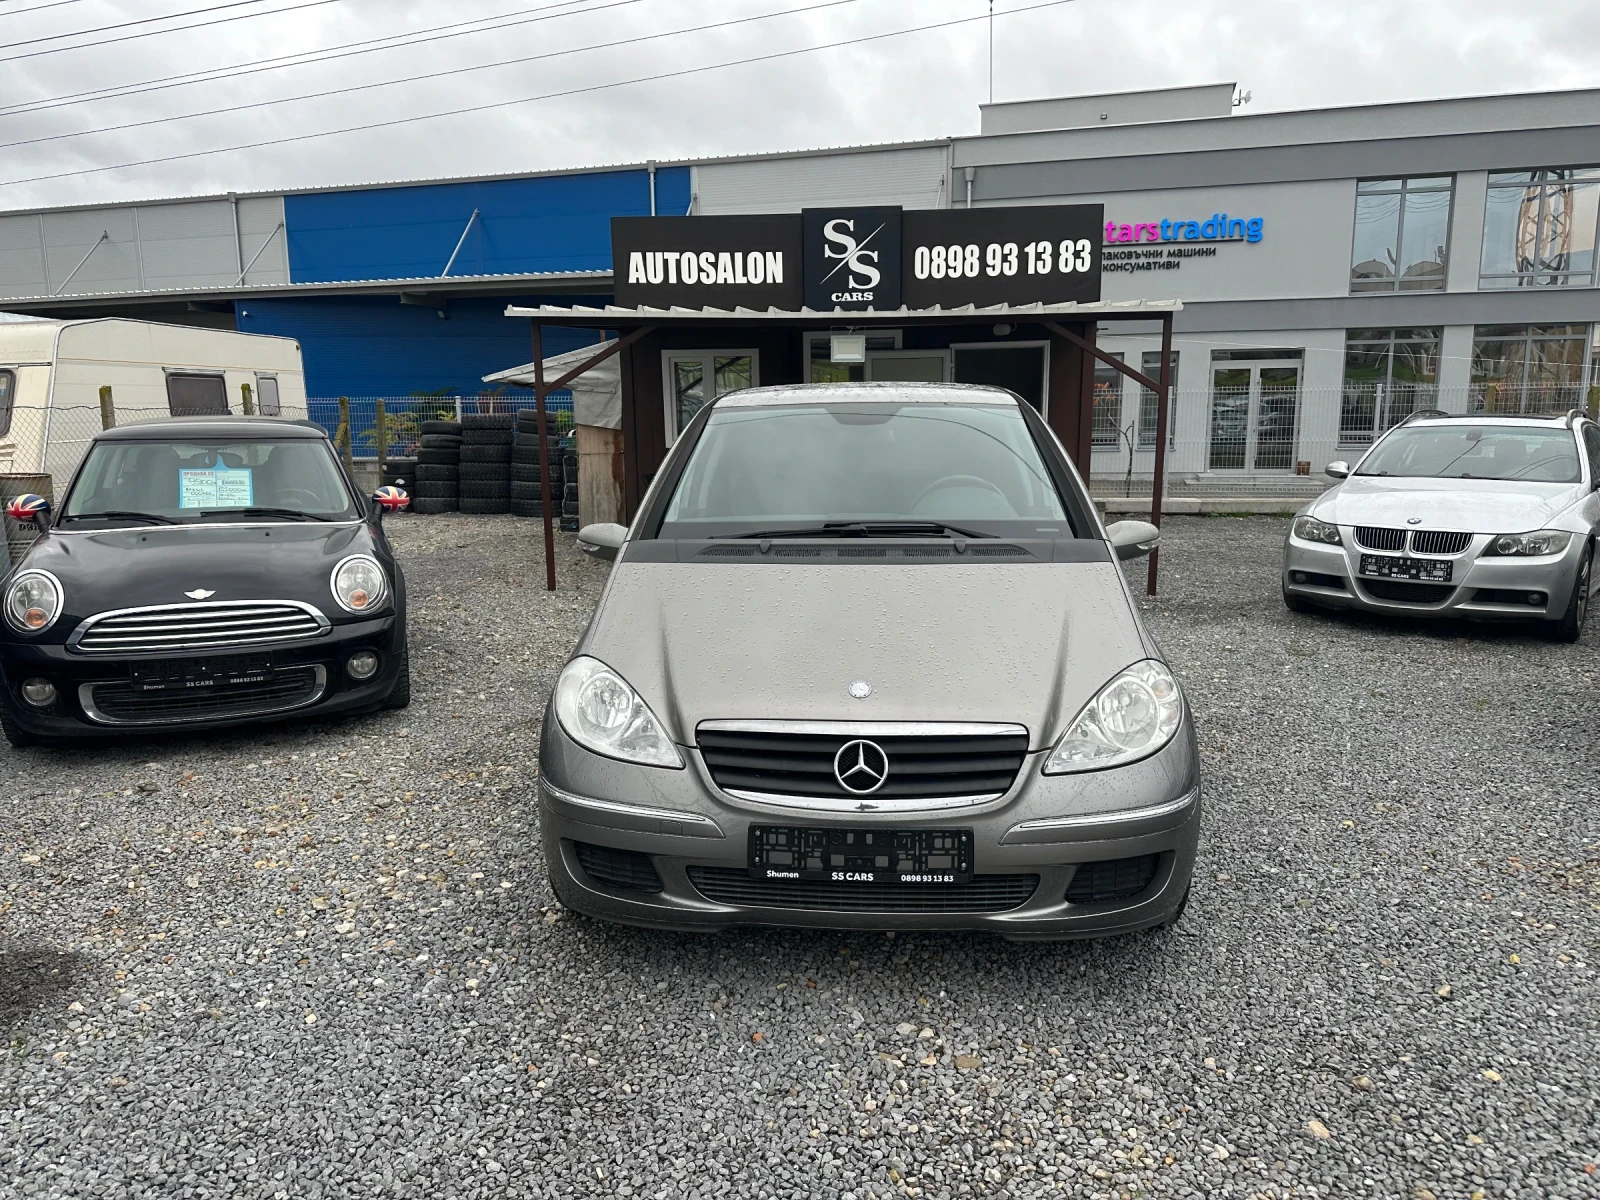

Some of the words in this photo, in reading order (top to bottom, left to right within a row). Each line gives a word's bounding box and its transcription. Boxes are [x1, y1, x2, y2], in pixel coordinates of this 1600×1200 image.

[1103, 214, 1264, 243] tarstrading
[1167, 246, 1217, 259] машини
[628, 251, 784, 286] AUTOSALON
[914, 243, 979, 280] 0898
[985, 241, 1019, 277] 93
[1023, 240, 1053, 275] 13
[1058, 238, 1093, 274] 83
[1102, 260, 1180, 274] консумативи
[830, 291, 875, 303] CARS
[195, 679, 214, 687] CARS
[766, 869, 799, 879] Shumen
[831, 871, 846, 881] SS
[846, 872, 874, 882] CARS
[901, 874, 922, 882] 0898
[922, 874, 932, 882] 93
[933, 874, 942, 882] 13
[943, 874, 954, 883] 83
